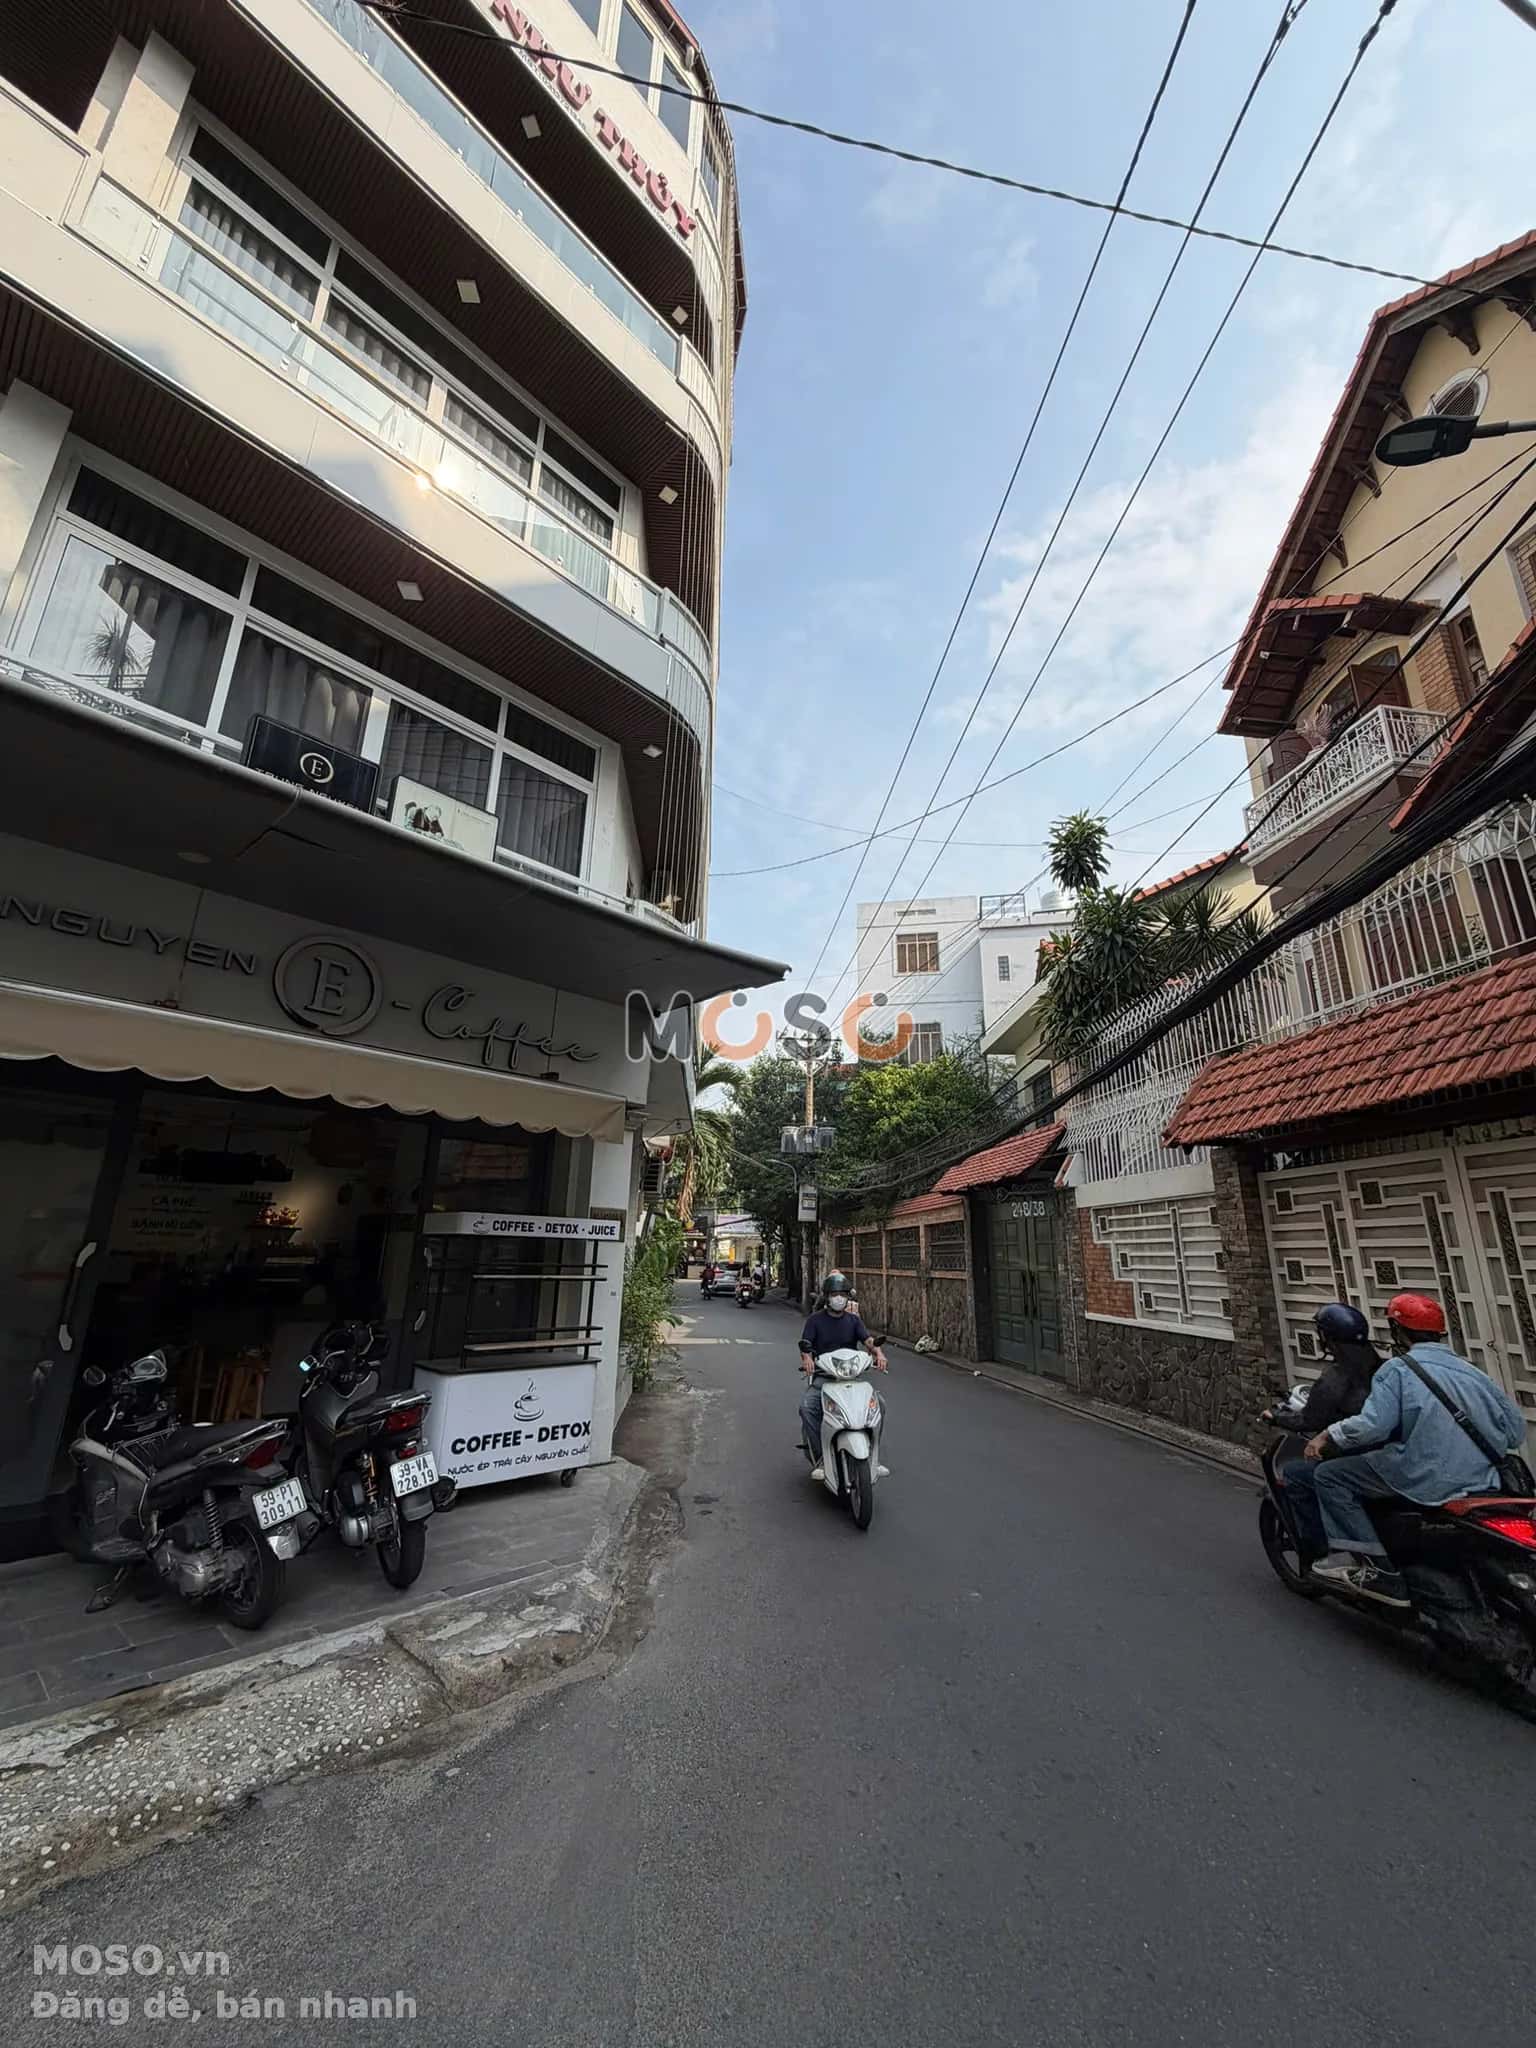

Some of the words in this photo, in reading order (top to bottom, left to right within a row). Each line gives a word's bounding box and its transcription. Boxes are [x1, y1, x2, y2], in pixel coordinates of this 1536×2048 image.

[0, 896, 257, 976] NGUYEN
[421, 984, 600, 1070] Coffee
[1010, 1200, 1046, 1218] 248/38
[491, 1219, 535, 1233] COFFEE
[545, 1222, 580, 1235] DETOX
[588, 1224, 616, 1237] JUICE
[450, 1430, 522, 1455] COFFEE
[537, 1420, 592, 1442] DETOX
[399, 1456, 429, 1478] 59-VA
[492, 1457, 513, 1469] TRÁI
[514, 1454, 532, 1465] CÂY
[534, 1448, 569, 1462] NGUYÊN
[397, 1468, 435, 1495] 228.19
[260, 1483, 295, 1509] 59-P1
[260, 1496, 304, 1527] 309.11
